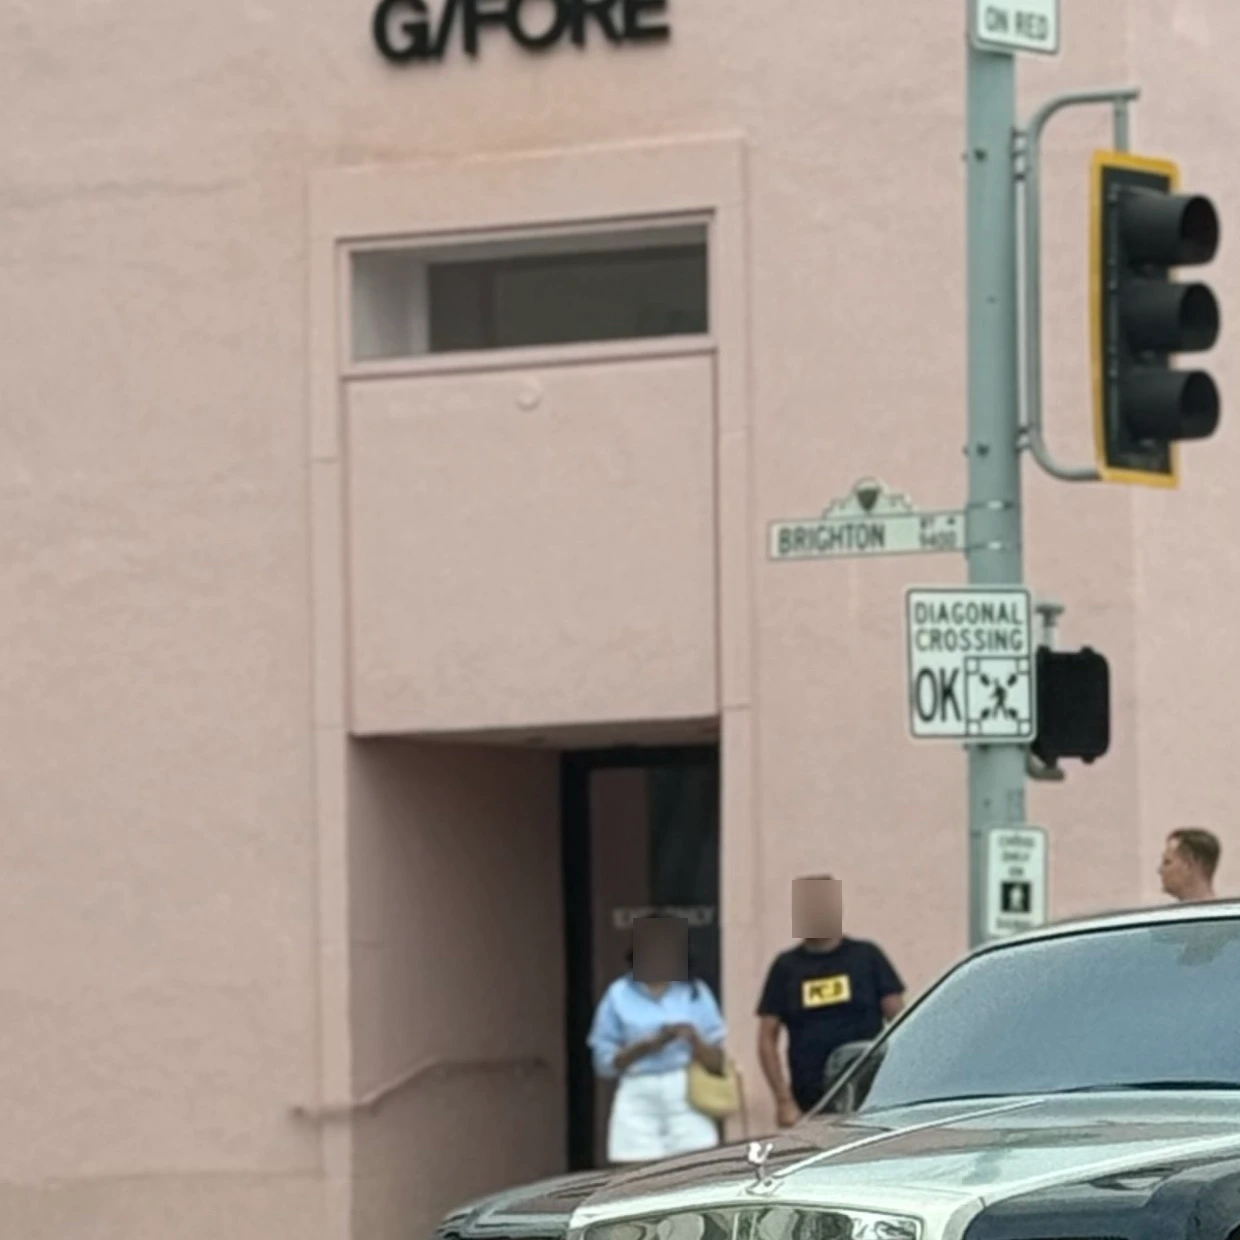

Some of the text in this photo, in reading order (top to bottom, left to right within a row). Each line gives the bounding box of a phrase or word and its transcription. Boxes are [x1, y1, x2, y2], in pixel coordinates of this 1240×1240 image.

[984, 6, 1049, 41] ON RED
[779, 523, 885, 554] BRIGHTON
[914, 601, 1024, 625] DIAGONAL
[915, 628, 1023, 652] CROSSING
[916, 667, 962, 722] OK
